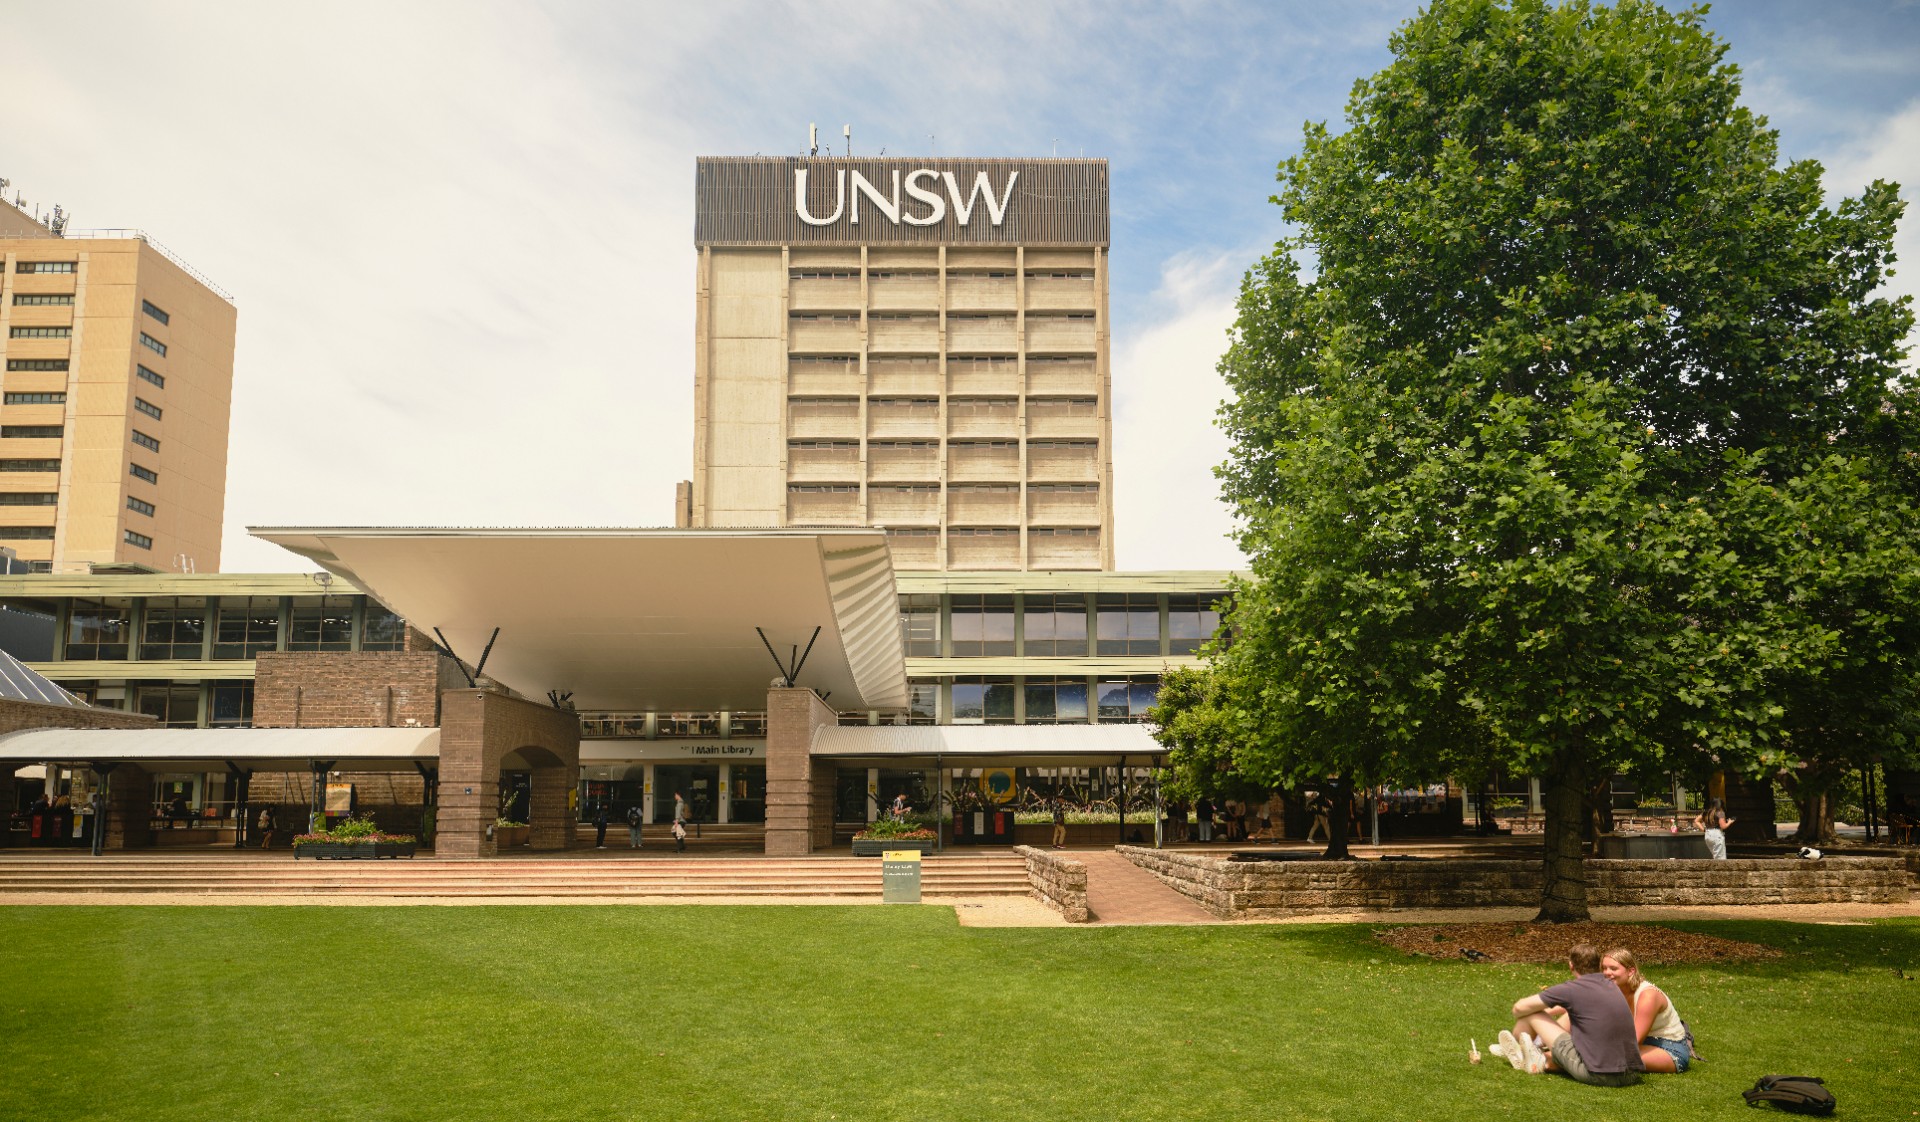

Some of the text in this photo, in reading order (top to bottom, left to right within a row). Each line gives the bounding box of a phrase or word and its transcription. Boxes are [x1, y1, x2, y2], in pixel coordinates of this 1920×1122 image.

[795, 168, 1019, 226] UNSW
[696, 745, 720, 754] Main
[722, 745, 754, 756] Library
